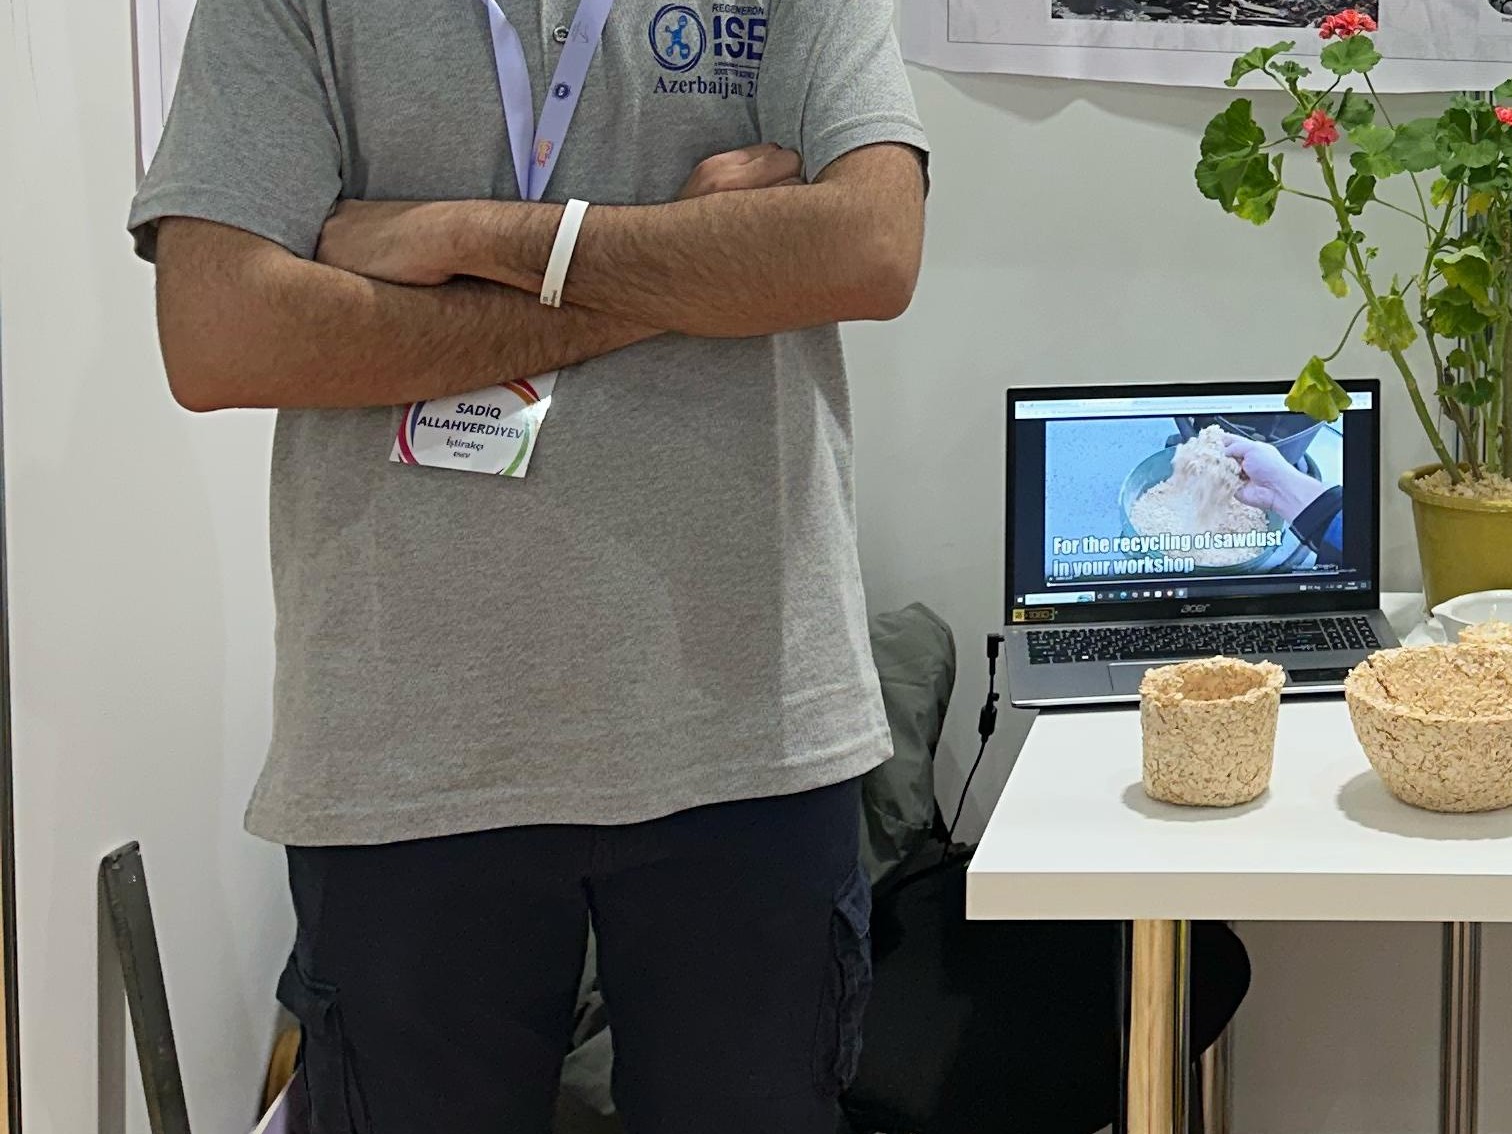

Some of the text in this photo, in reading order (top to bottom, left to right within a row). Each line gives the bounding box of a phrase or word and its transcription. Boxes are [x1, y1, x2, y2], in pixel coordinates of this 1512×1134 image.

[455, 402, 501, 420] SADİQ
[417, 416, 524, 439] ALLAHVERDİYEV
[1053, 530, 1281, 555] For the recycling of sawdust
[1053, 555, 1195, 577] in your workshop
